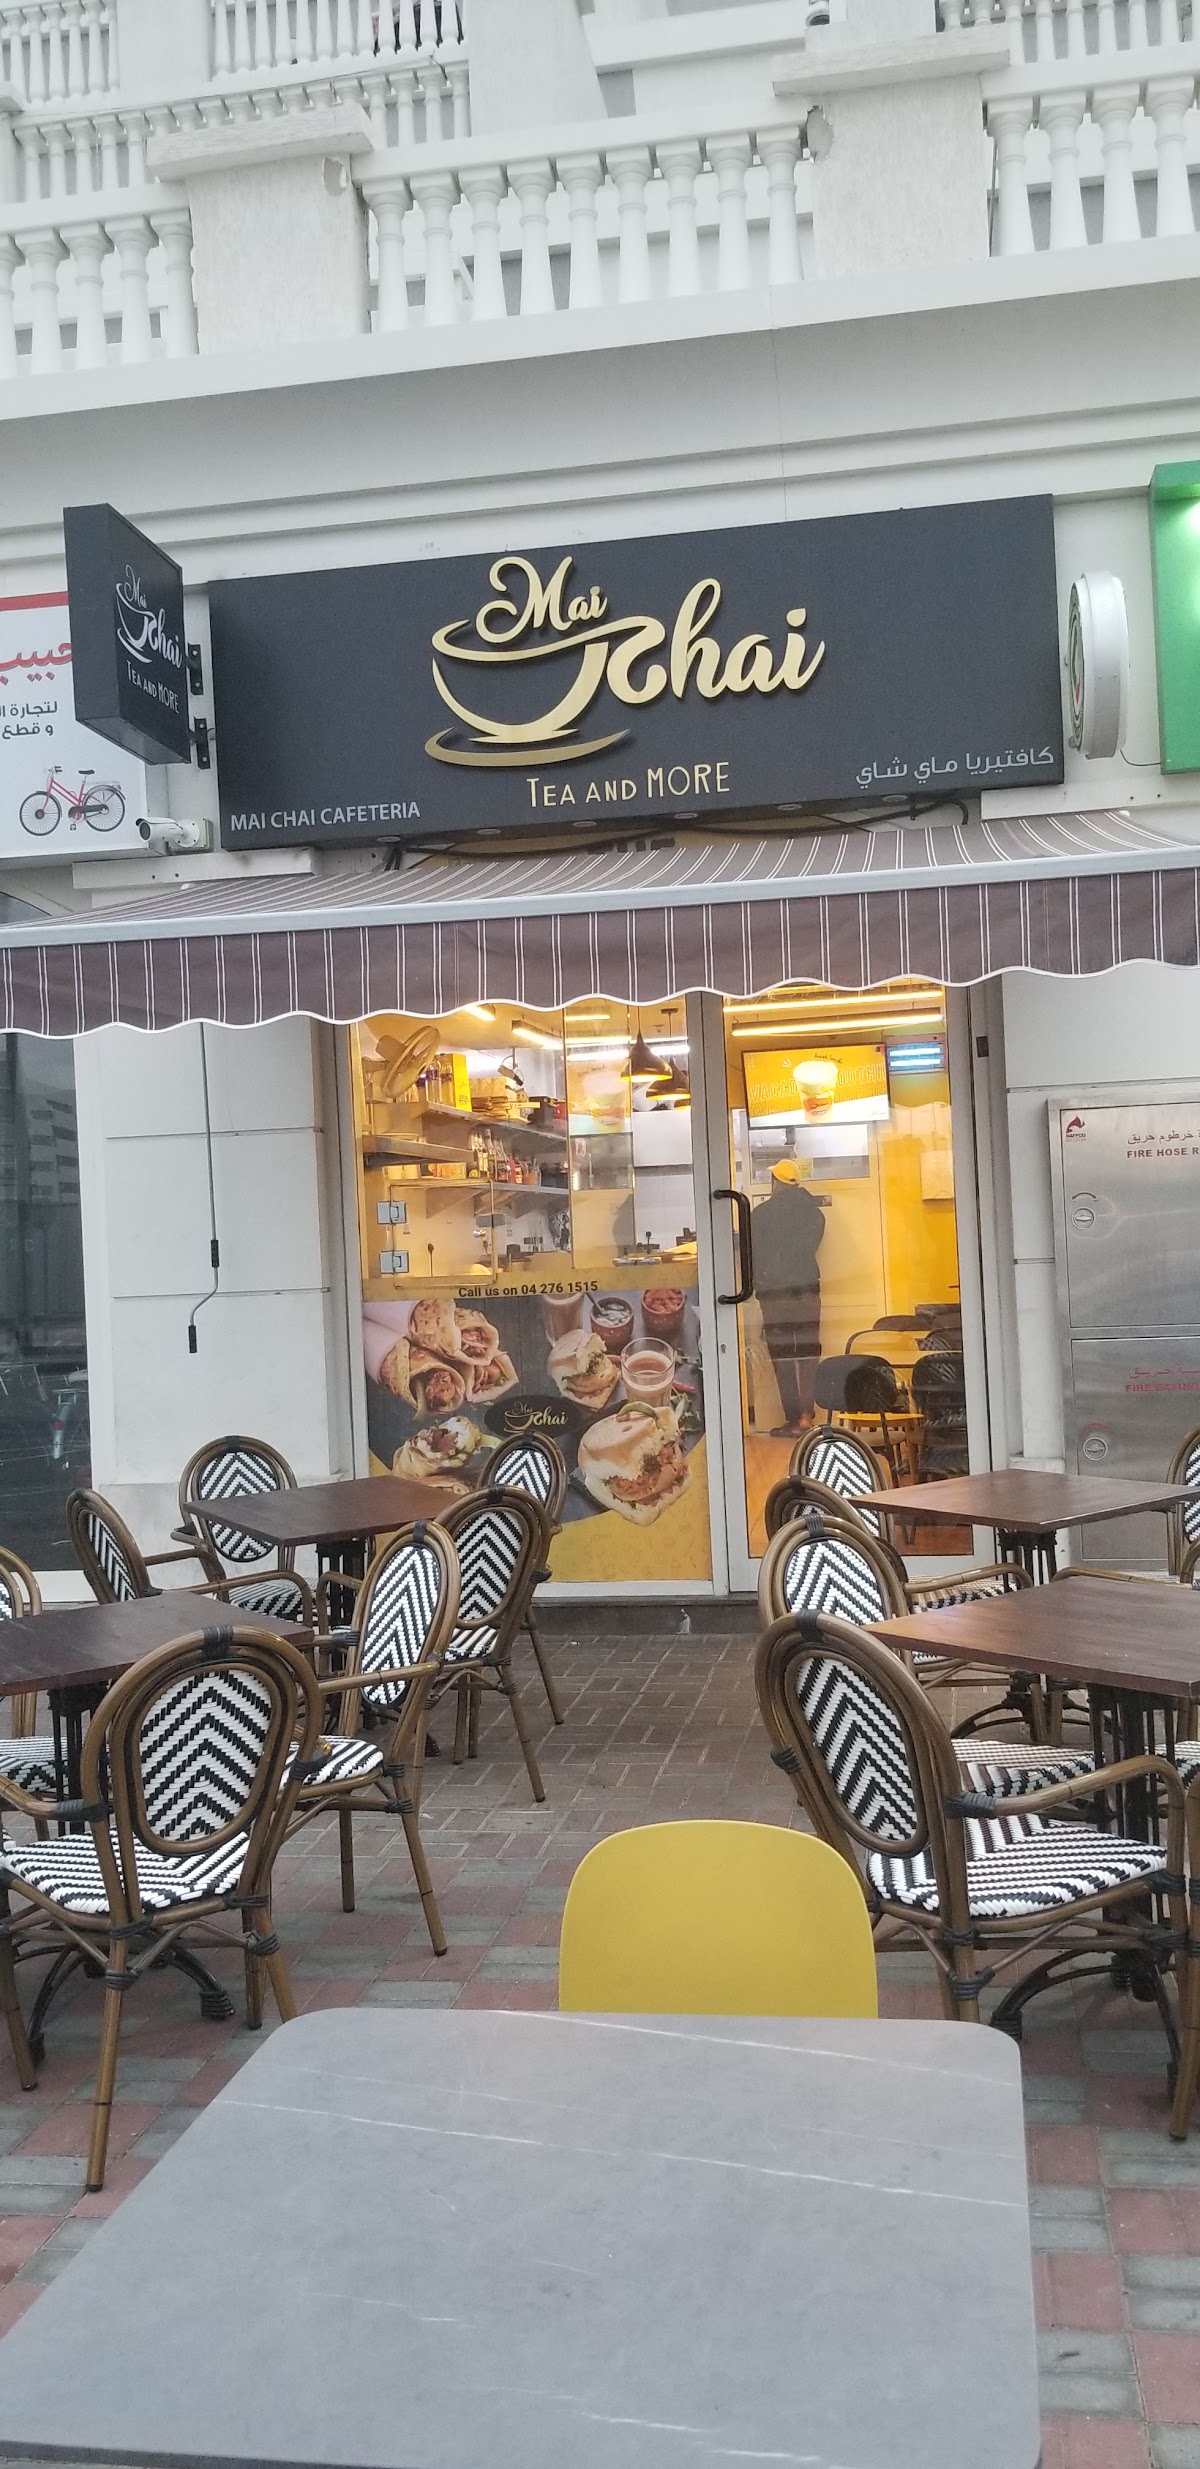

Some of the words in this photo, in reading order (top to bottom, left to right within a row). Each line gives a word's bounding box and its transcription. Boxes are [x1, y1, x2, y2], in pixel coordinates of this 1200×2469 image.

[475, 556, 608, 643] Mai
[606, 578, 826, 704] Chai
[9, 700, 58, 719] لتجارة
[158, 682, 180, 714] MORE
[2, 721, 41, 740] قطع
[45, 724, 54, 737] و
[855, 756, 908, 790] شاي
[913, 756, 959, 785] ماي
[965, 746, 1055, 776] كافتيريا
[526, 777, 576, 808] TEA
[585, 779, 637, 804] AND
[647, 761, 730, 799] MORE
[230, 812, 267, 832] MAI
[270, 808, 316, 829] CHAI
[320, 801, 422, 825] CAFETERIA
[1127, 1133, 1156, 1145] حريق
[1158, 1129, 1194, 1144] خرطوم
[1126, 1149, 1153, 1159] FIRE
[1156, 1147, 1188, 1157] HOSE
[458, 1287, 481, 1298] Call
[485, 1287, 500, 1297] us
[503, 1286, 518, 1296] on
[521, 1283, 537, 1295] 04
[540, 1282, 564, 1294] 276
[567, 1280, 598, 1293] 1515
[1125, 1384, 1152, 1393] FIRE
